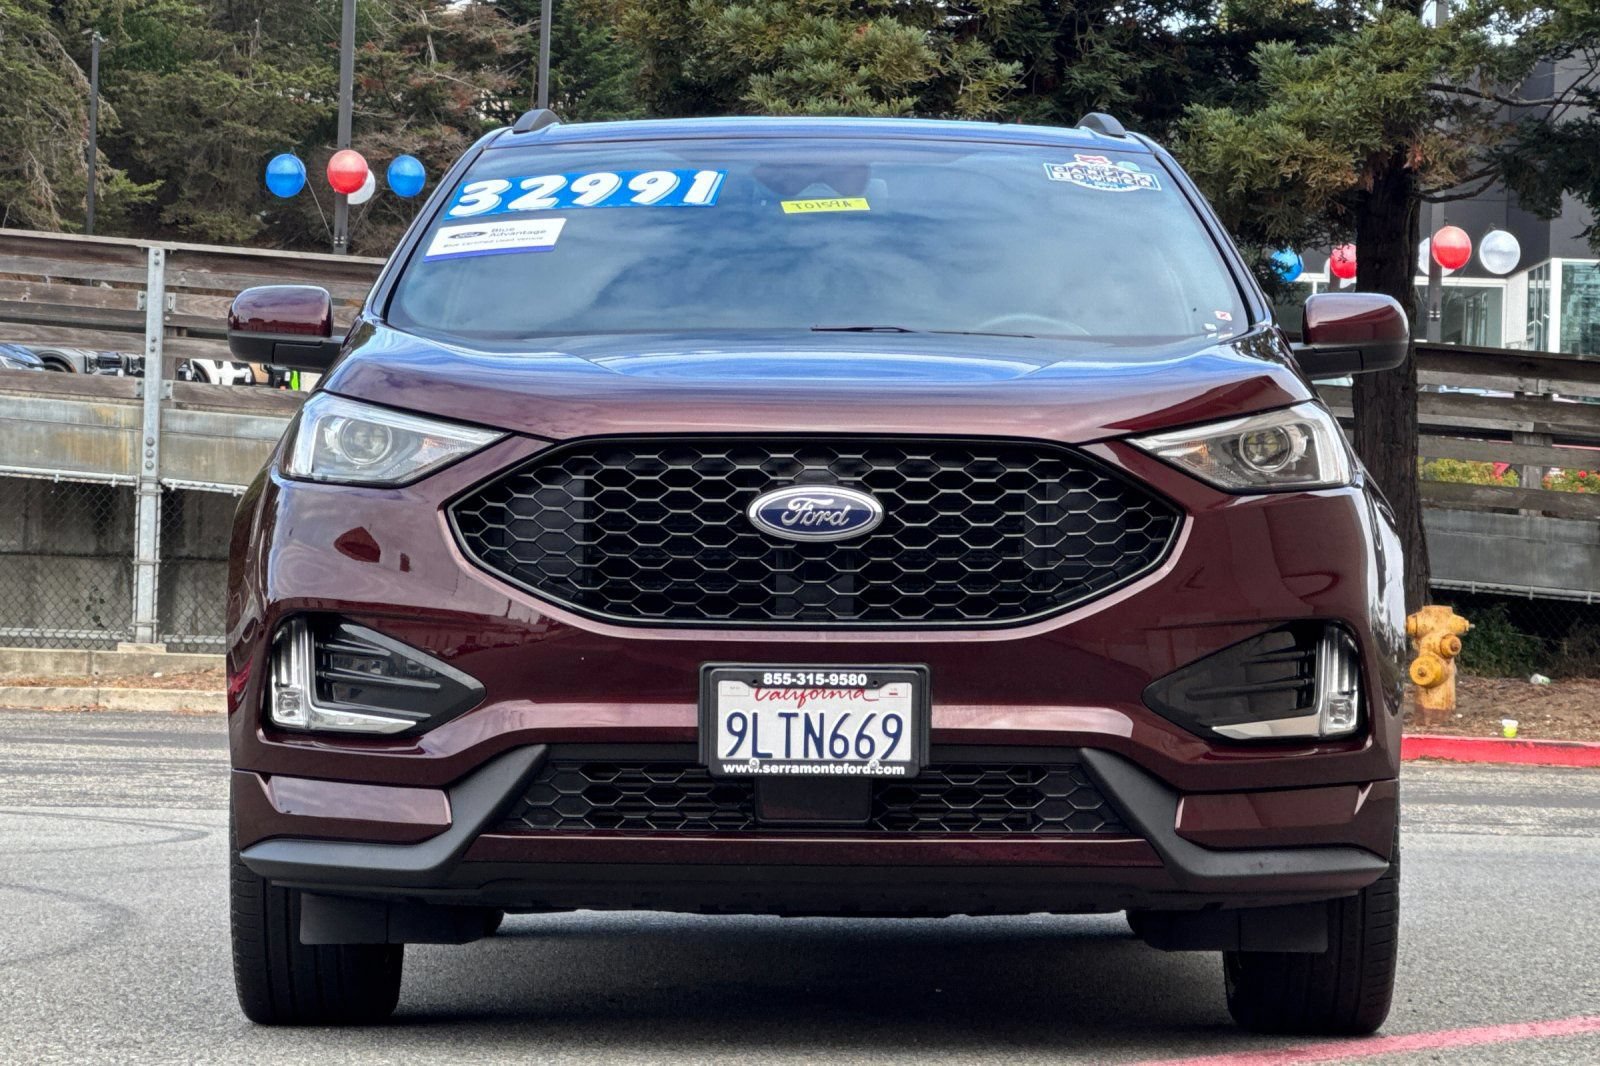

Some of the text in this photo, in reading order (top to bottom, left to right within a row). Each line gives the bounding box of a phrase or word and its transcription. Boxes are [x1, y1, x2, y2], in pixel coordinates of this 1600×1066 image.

[449, 170, 723, 217] 32991
[489, 229, 547, 238] Advantage
[781, 497, 851, 526] Ford
[763, 673, 868, 686] 855-315-9580
[753, 688, 880, 709] California
[726, 711, 903, 760] 9LTN669
[723, 762, 905, 775] www.serramonteford.com
